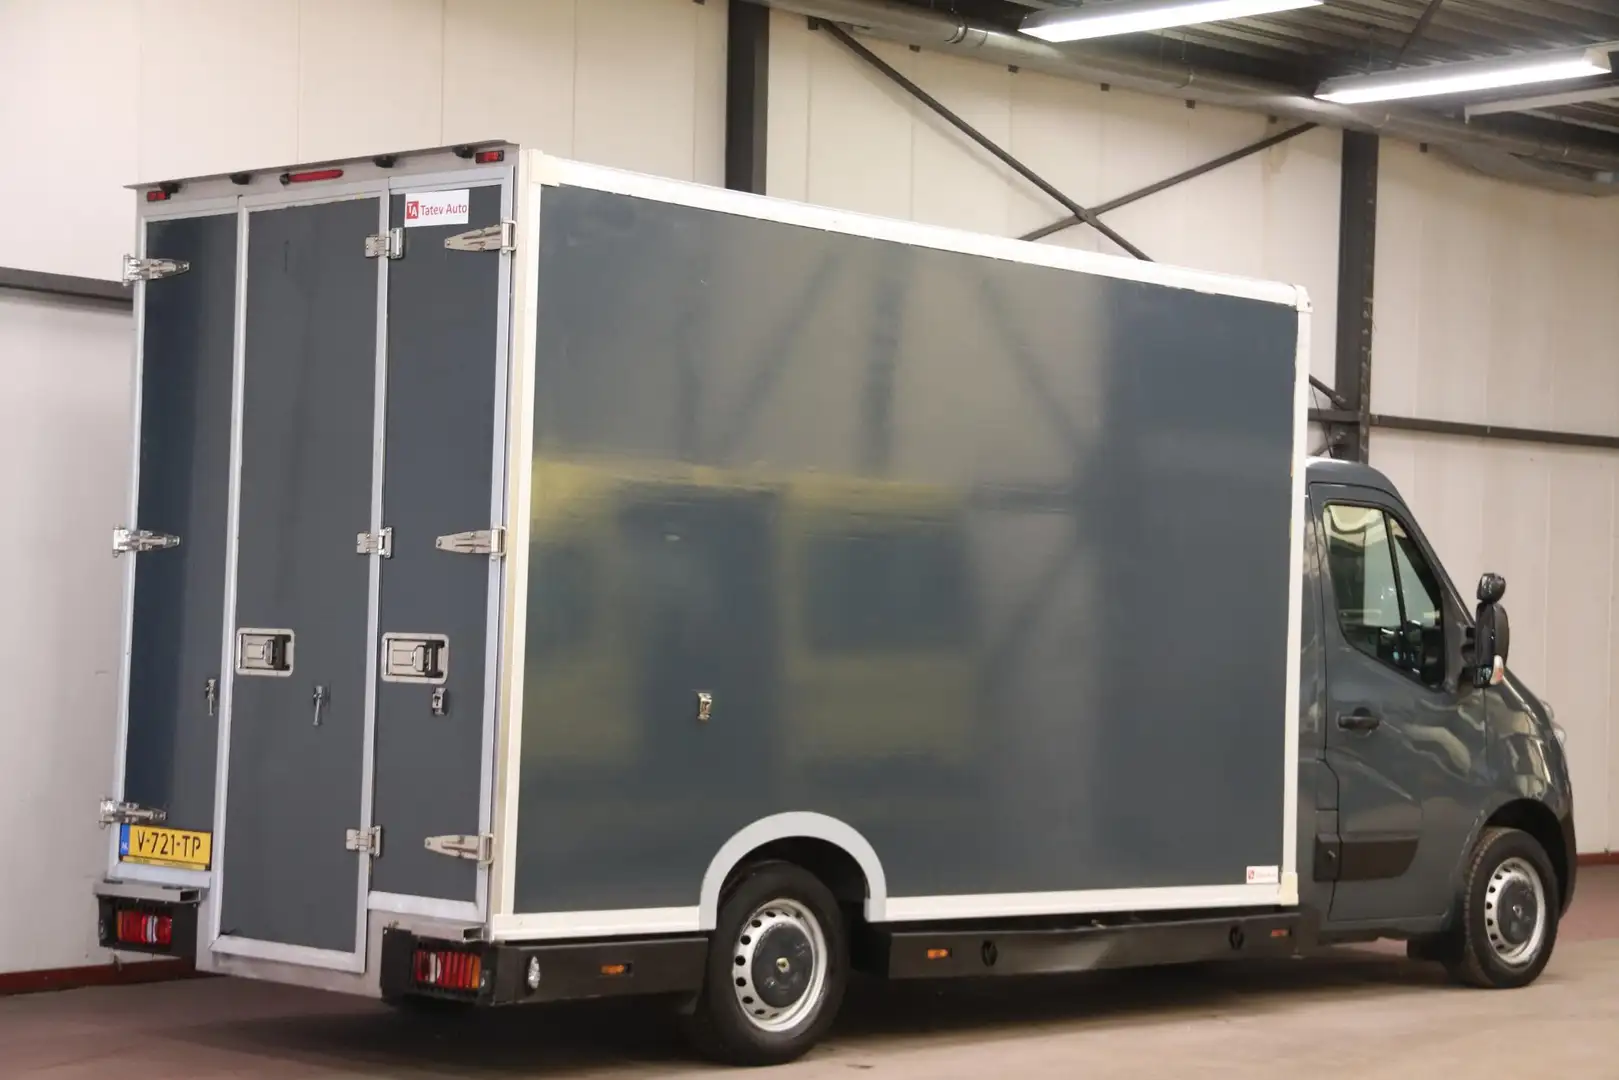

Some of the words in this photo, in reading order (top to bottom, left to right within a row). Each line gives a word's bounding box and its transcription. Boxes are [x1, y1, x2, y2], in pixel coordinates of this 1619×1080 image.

[420, 204, 444, 216] Tatev
[446, 203, 468, 215] Auto
[137, 829, 201, 858] V-721-TP
